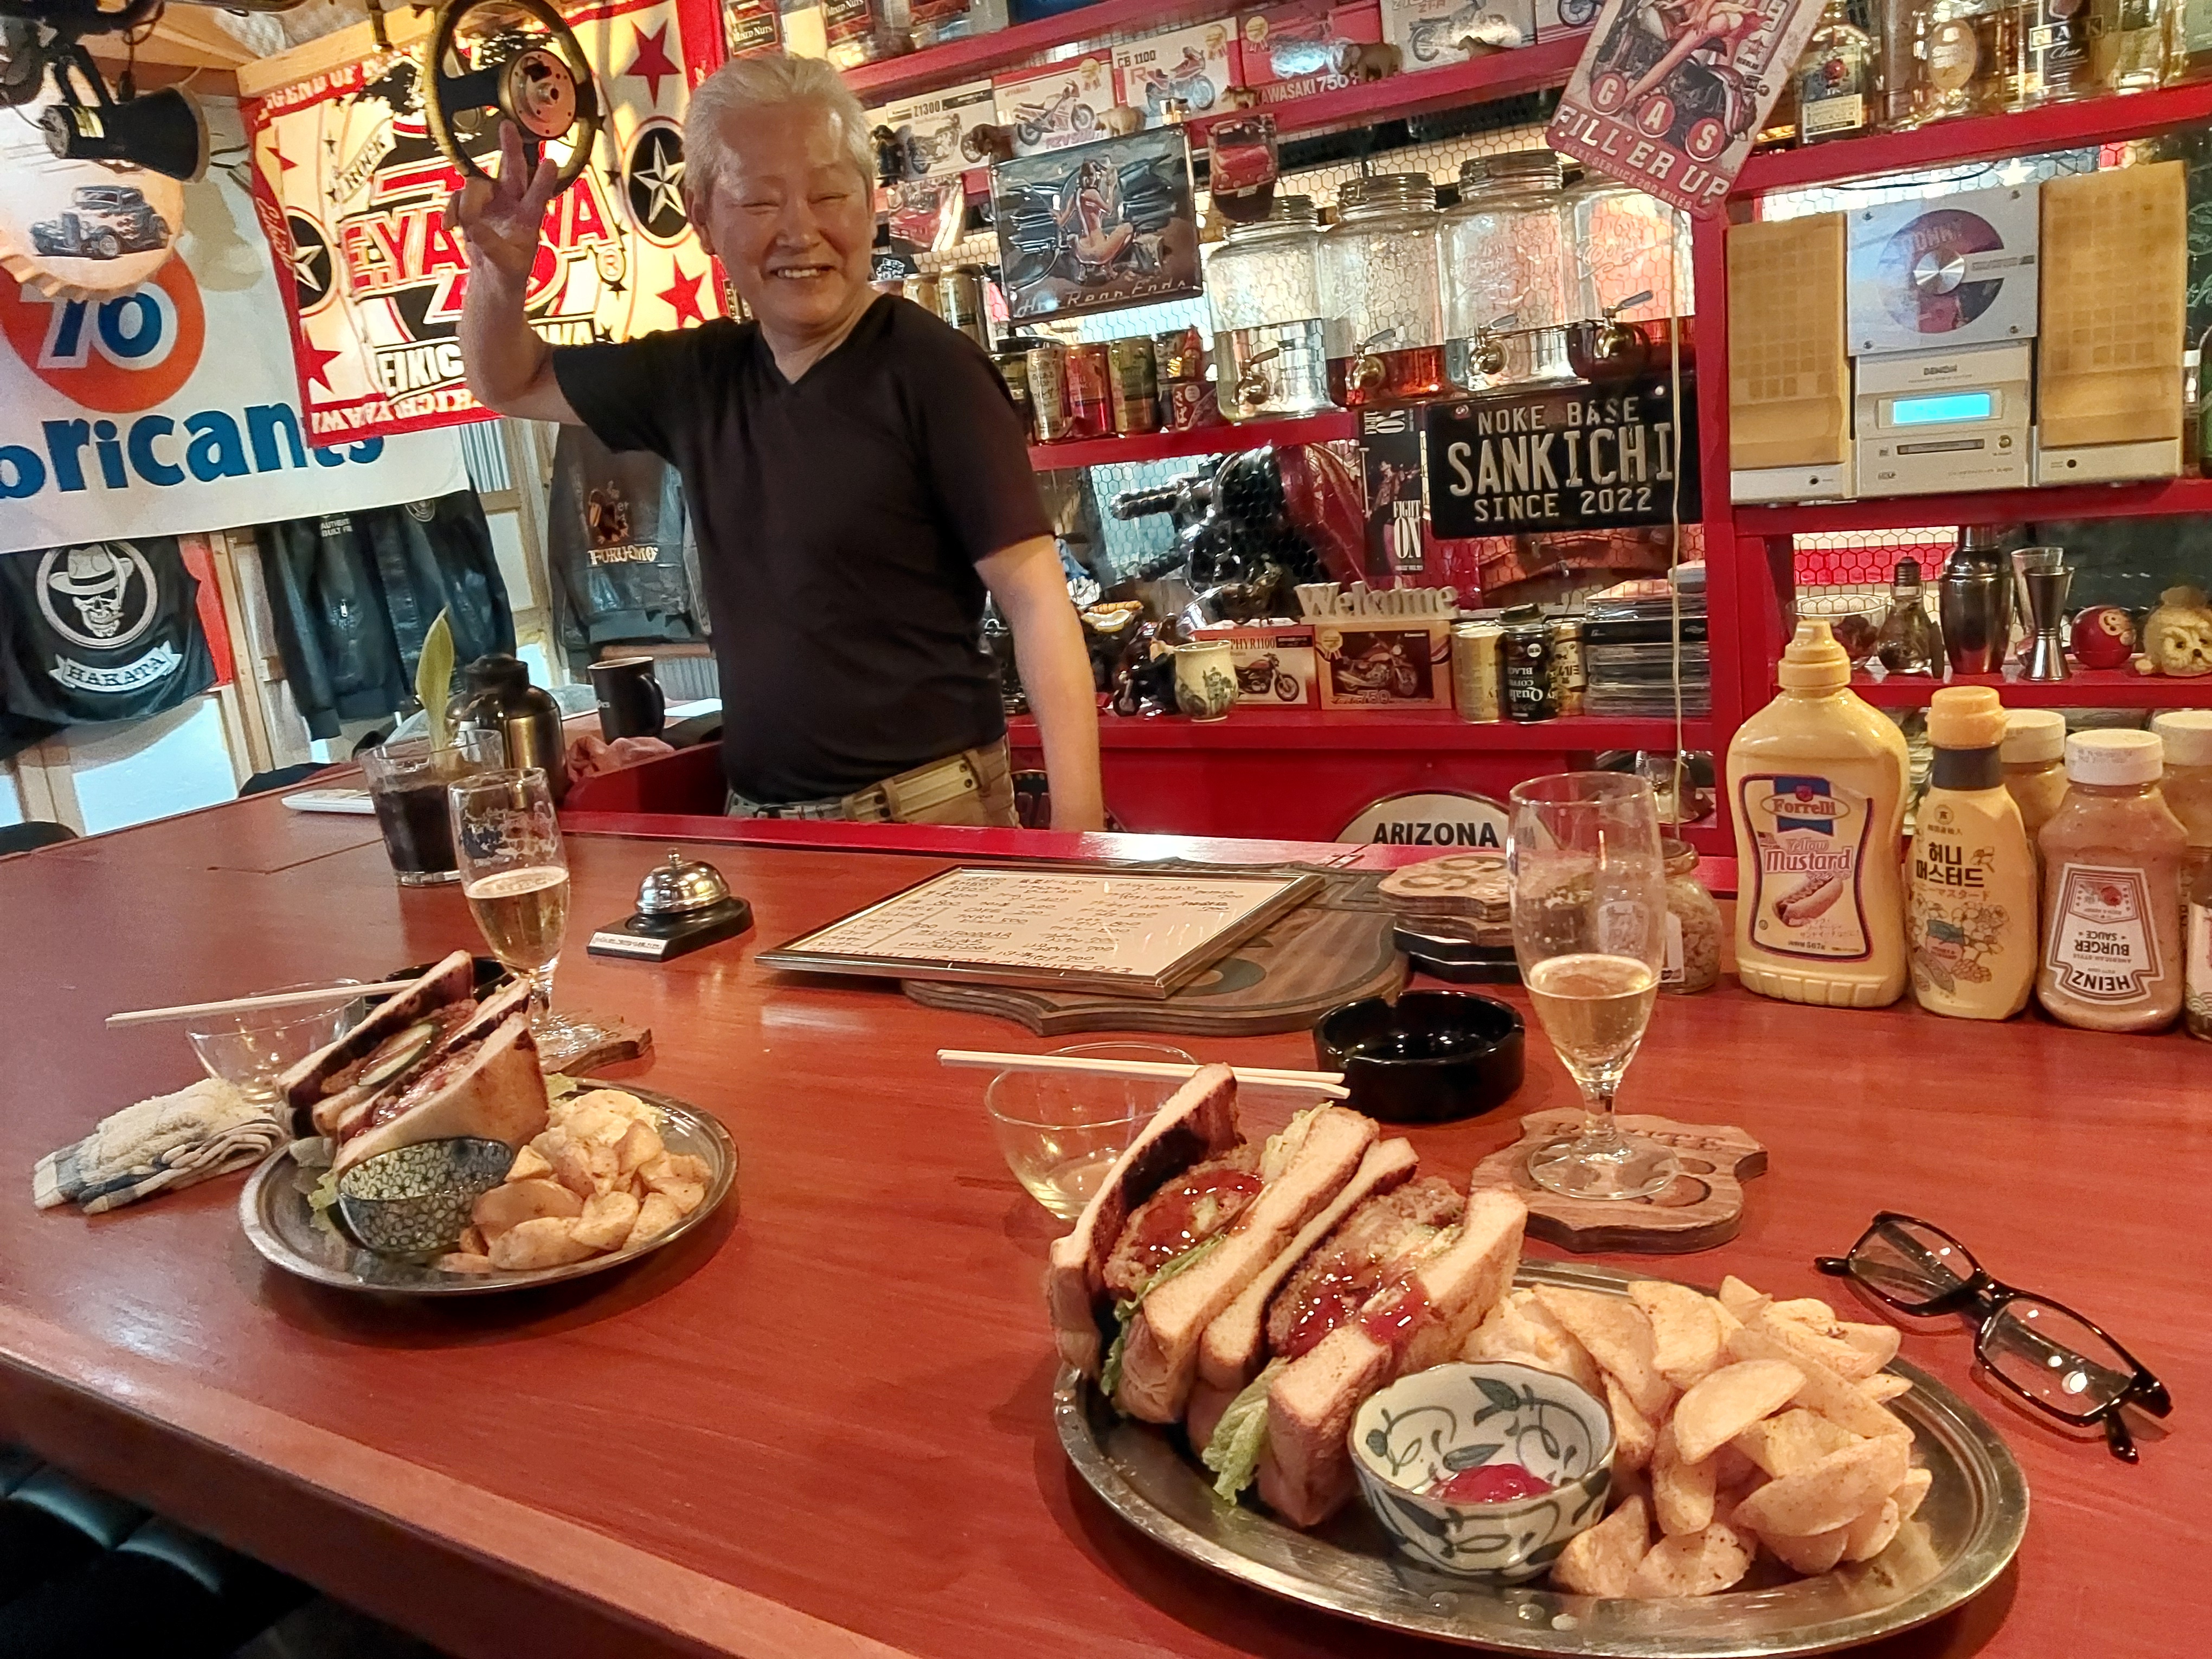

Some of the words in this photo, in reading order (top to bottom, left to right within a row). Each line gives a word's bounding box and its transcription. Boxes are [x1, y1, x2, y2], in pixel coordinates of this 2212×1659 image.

[827, 5, 845, 15] MIXED
[733, 30, 753, 42] MIXED
[754, 26, 773, 36] NUTS
[1117, 56, 1131, 68] CB
[1134, 50, 1156, 64] 1100
[1318, 73, 1349, 93] 750
[914, 100, 941, 118] Z1300
[1598, 78, 1718, 151] GAS
[1679, 164, 1729, 198] UP
[1478, 405, 1546, 435] NOKE
[1567, 396, 1641, 428] BASE
[1448, 423, 1673, 497] SANKICHI
[1393, 500, 1421, 518] FIGHT
[1474, 492, 1560, 523] SINCE
[1580, 487, 1652, 516] 2022
[1394, 516, 1422, 559] ON
[1295, 581, 1461, 619] Welcome
[67, 657, 165, 687] HAKATA
[1772, 799, 1837, 815] Forrelli
[1373, 822, 1500, 847] ARIZONA
[1787, 838, 1829, 852] Yellow
[1765, 847, 1853, 872] Mustard
[1928, 841, 1963, 866] 허니
[1916, 859, 1985, 888] 머스터드
[2074, 939, 2130, 956] BURGER
[2085, 930, 2118, 941] SAUCE
[2072, 970, 2131, 992] HEINZ
